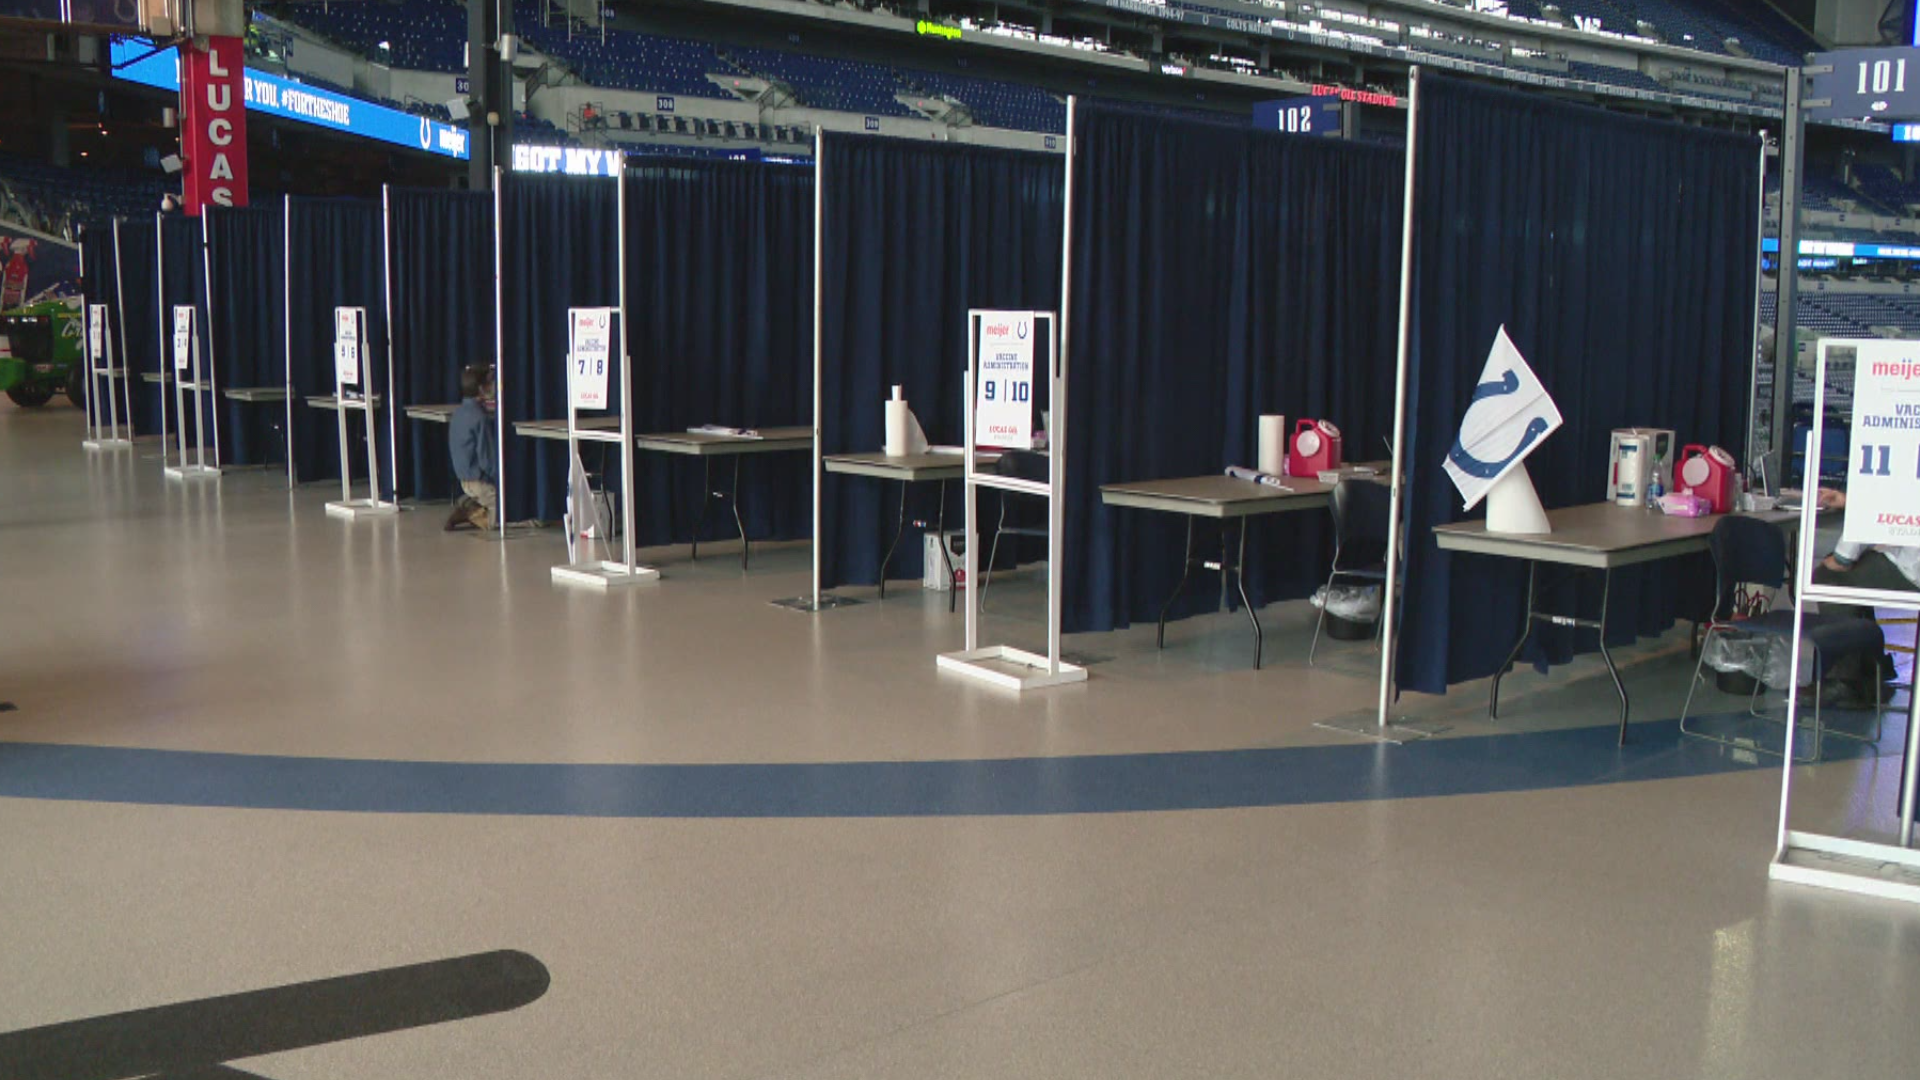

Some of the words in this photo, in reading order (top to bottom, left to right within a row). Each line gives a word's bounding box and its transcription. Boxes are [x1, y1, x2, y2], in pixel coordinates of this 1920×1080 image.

[1226, 17, 1247, 32] COLTS
[1249, 20, 1273, 36] NATION
[1857, 58, 1906, 95] 101
[255, 80, 279, 108] YOU.
[281, 86, 350, 126] #FORTHESHOE
[1341, 88, 1355, 101] OIL
[1357, 90, 1398, 107] STADIUM
[206, 49, 234, 207] LUCAS
[1278, 105, 1311, 133] 102
[515, 145, 562, 172] GOT
[563, 148, 603, 175] MY
[986, 323, 1010, 338] meijer
[578, 359, 585, 375] 7
[597, 359, 603, 375] 8
[985, 381, 996, 401] 9
[1012, 381, 1029, 402] 10
[1859, 445, 1891, 476] 11
